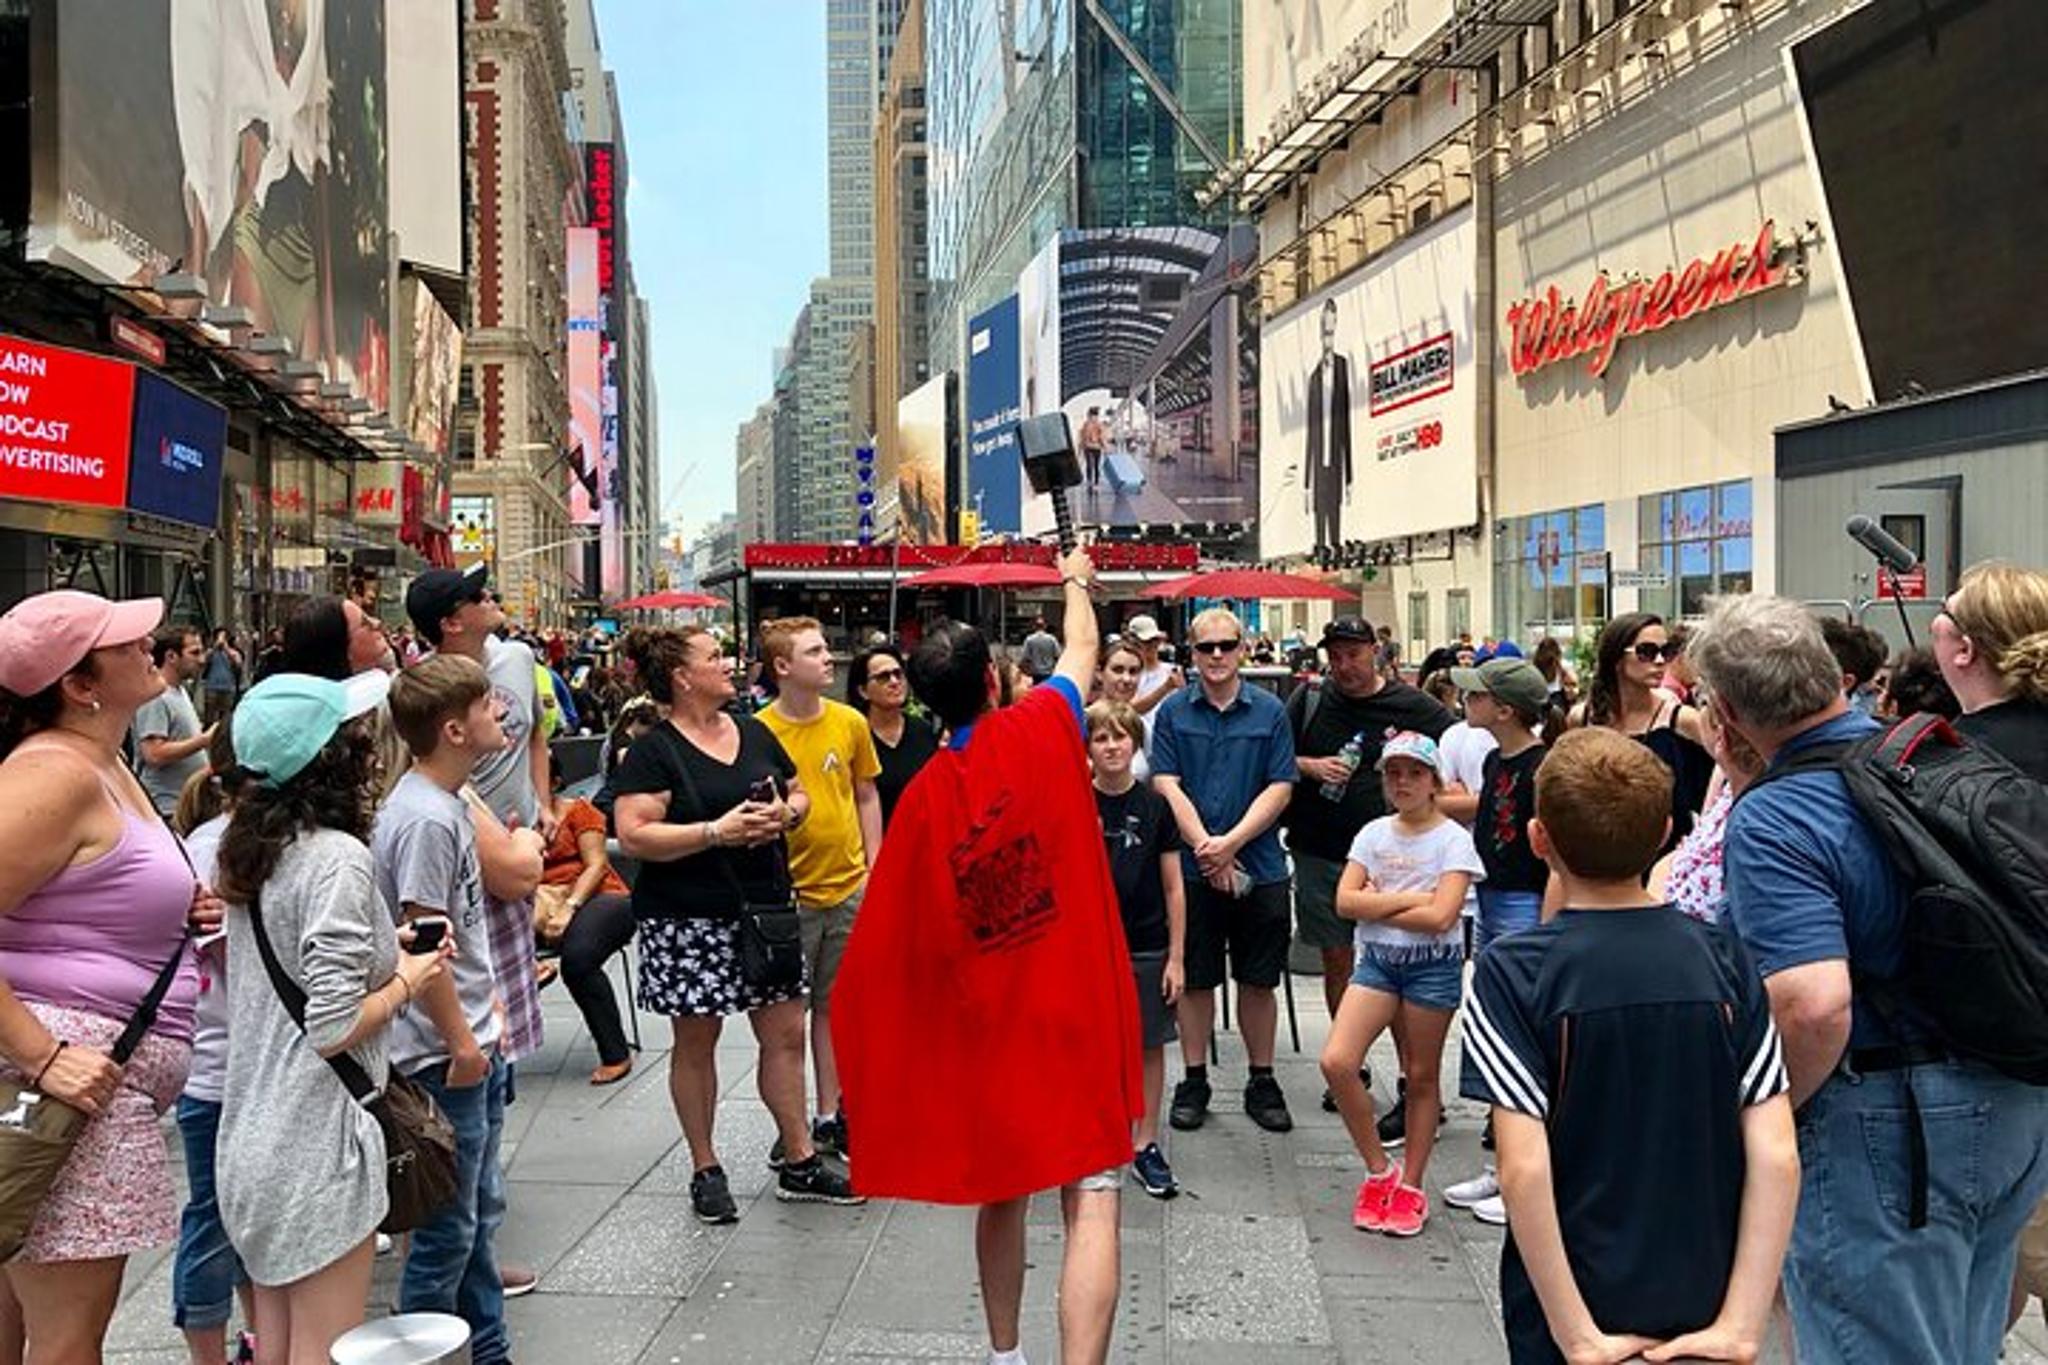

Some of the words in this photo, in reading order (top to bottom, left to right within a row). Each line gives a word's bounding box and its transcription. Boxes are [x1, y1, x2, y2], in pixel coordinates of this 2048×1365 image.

[591, 150, 612, 229] Locker
[1507, 220, 1786, 377] Walgreens
[0, 350, 47, 376] ARN
[1373, 366, 1397, 393] BILL
[0, 414, 69, 441] DCAST
[0, 444, 104, 478] VERTISING
